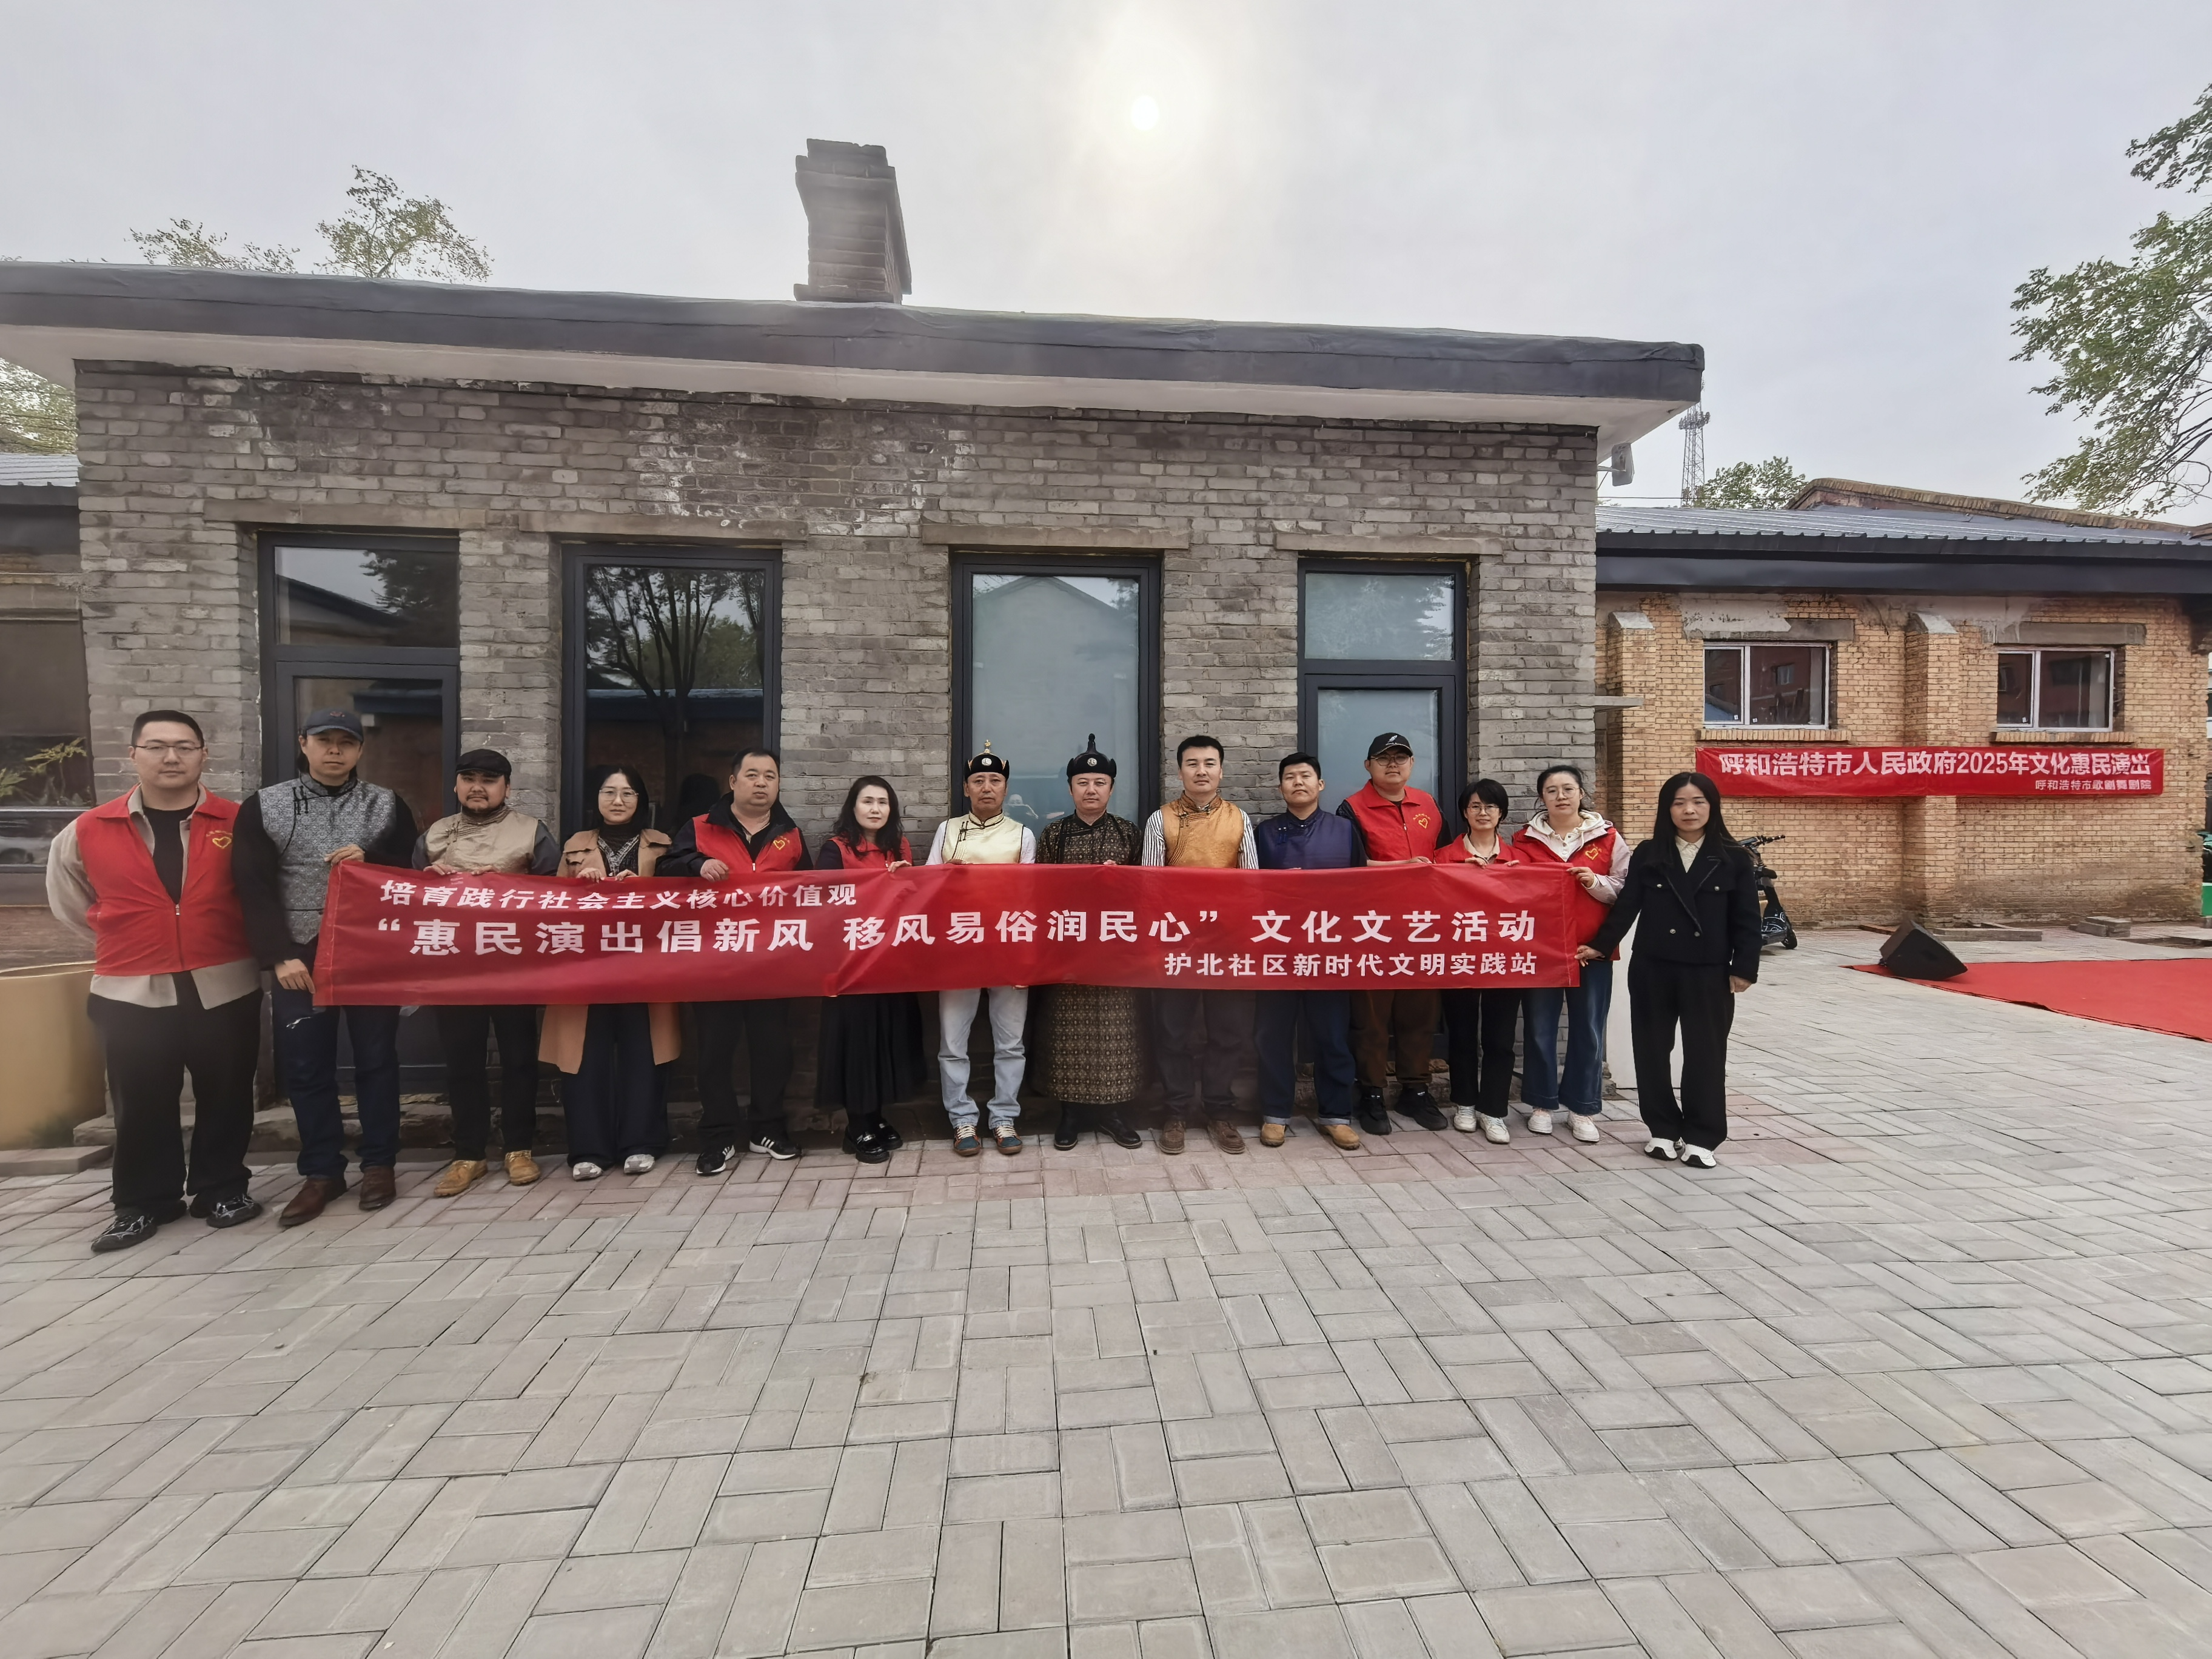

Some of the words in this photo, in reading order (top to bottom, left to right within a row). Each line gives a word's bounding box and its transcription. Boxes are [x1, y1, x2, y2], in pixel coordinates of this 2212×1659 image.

[1718, 751, 2151, 776] 呼和浩特市人民政府2025年文化惠民演出
[380, 879, 857, 910] 培育践行社会主义核心价值观
[1250, 910, 1535, 943] 文化文艺活动
[1164, 952, 1537, 977] 护北社区新时代文明实践站
